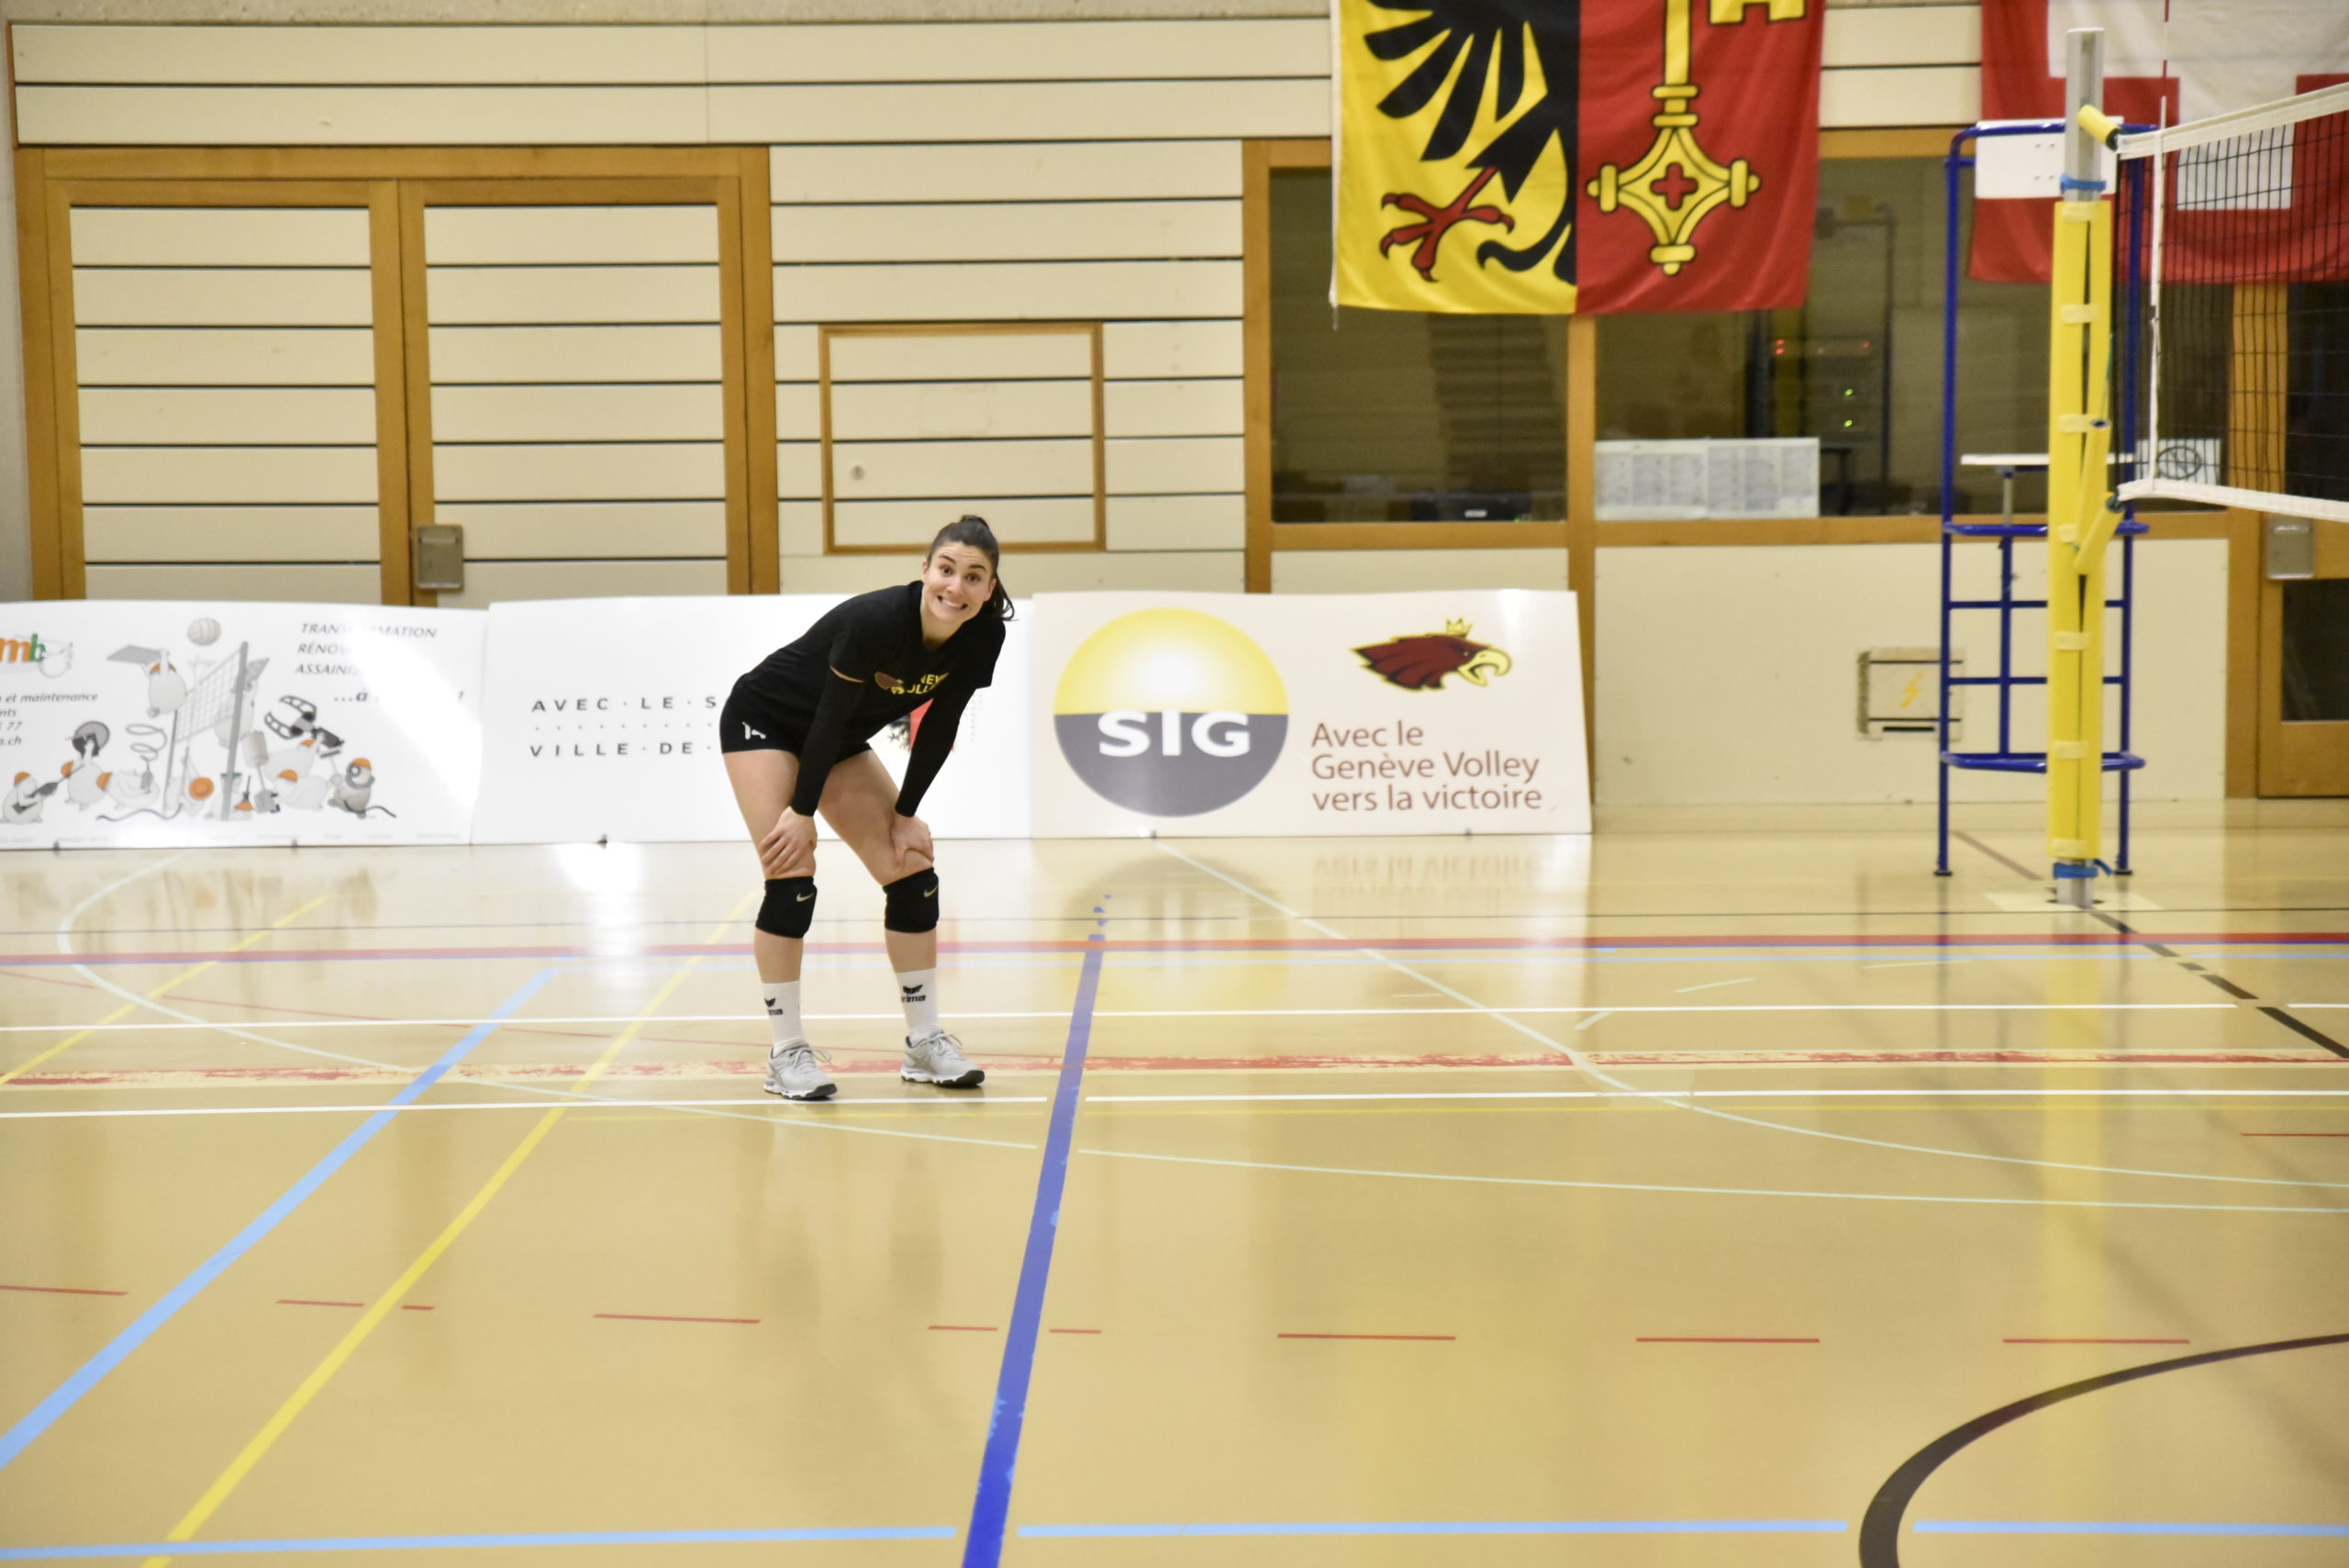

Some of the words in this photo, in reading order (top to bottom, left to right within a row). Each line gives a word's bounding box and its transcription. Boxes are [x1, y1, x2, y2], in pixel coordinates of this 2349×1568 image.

[20, 694, 98, 703] maintenance
[1098, 710, 1251, 758] SIG
[1311, 722, 1387, 748] Avec
[1397, 720, 1424, 746] le
[1312, 752, 1434, 779] Genève
[1442, 750, 1540, 784] Volley
[1312, 792, 1378, 811] vers
[1388, 784, 1413, 810] la
[1422, 783, 1542, 809] victoire
